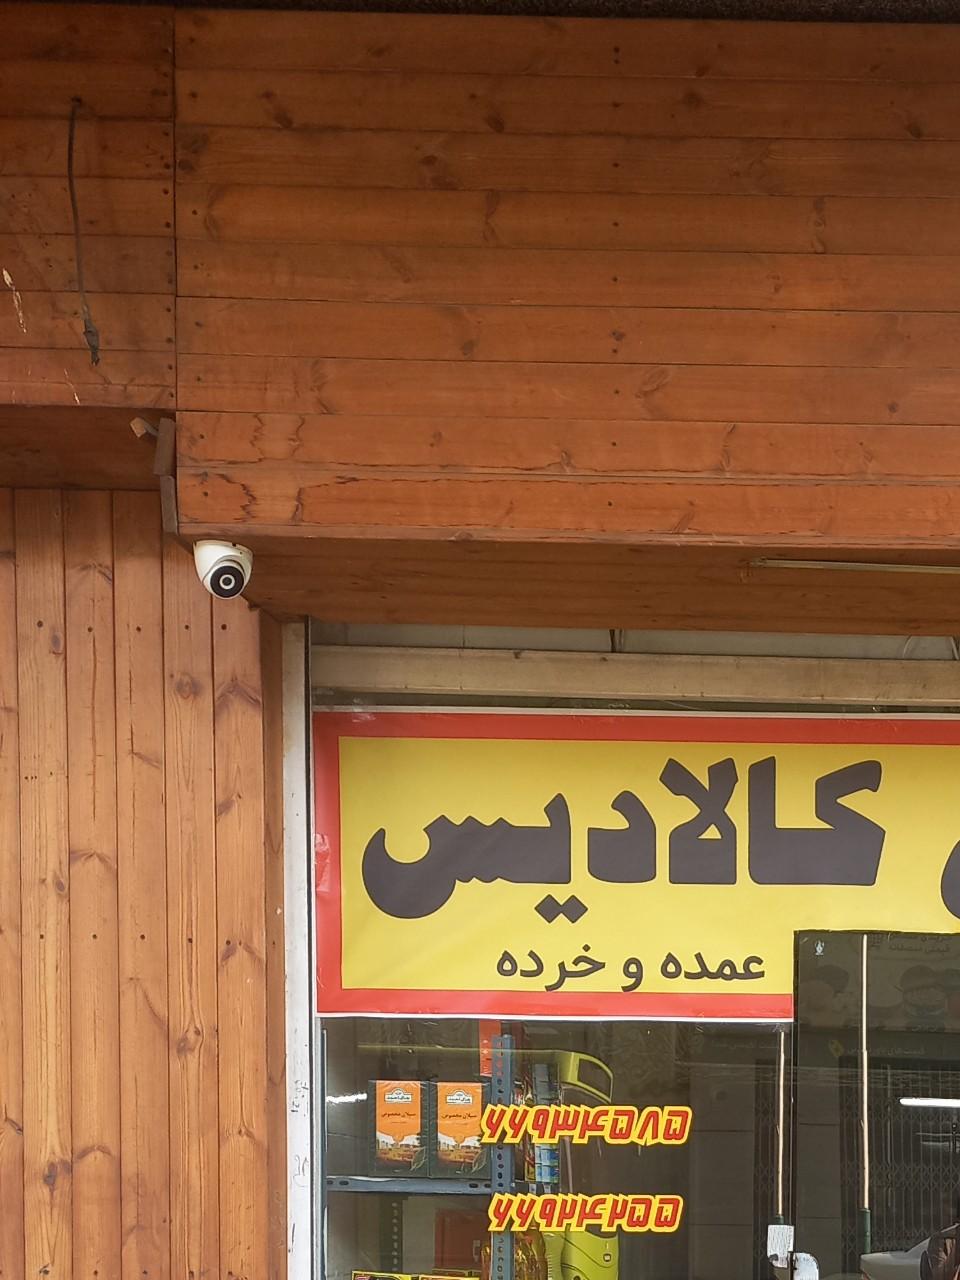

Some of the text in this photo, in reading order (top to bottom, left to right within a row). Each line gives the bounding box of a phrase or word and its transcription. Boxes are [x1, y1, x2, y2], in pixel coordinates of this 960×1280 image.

[361, 756, 886, 924] کالادیس
[497, 943, 765, 992] عمده و خرده
[482, 1105, 691, 1145] ۶۶۹۳۴۵۸۵
[488, 1193, 684, 1233] ۶۶۹۲۴۲۵۵
